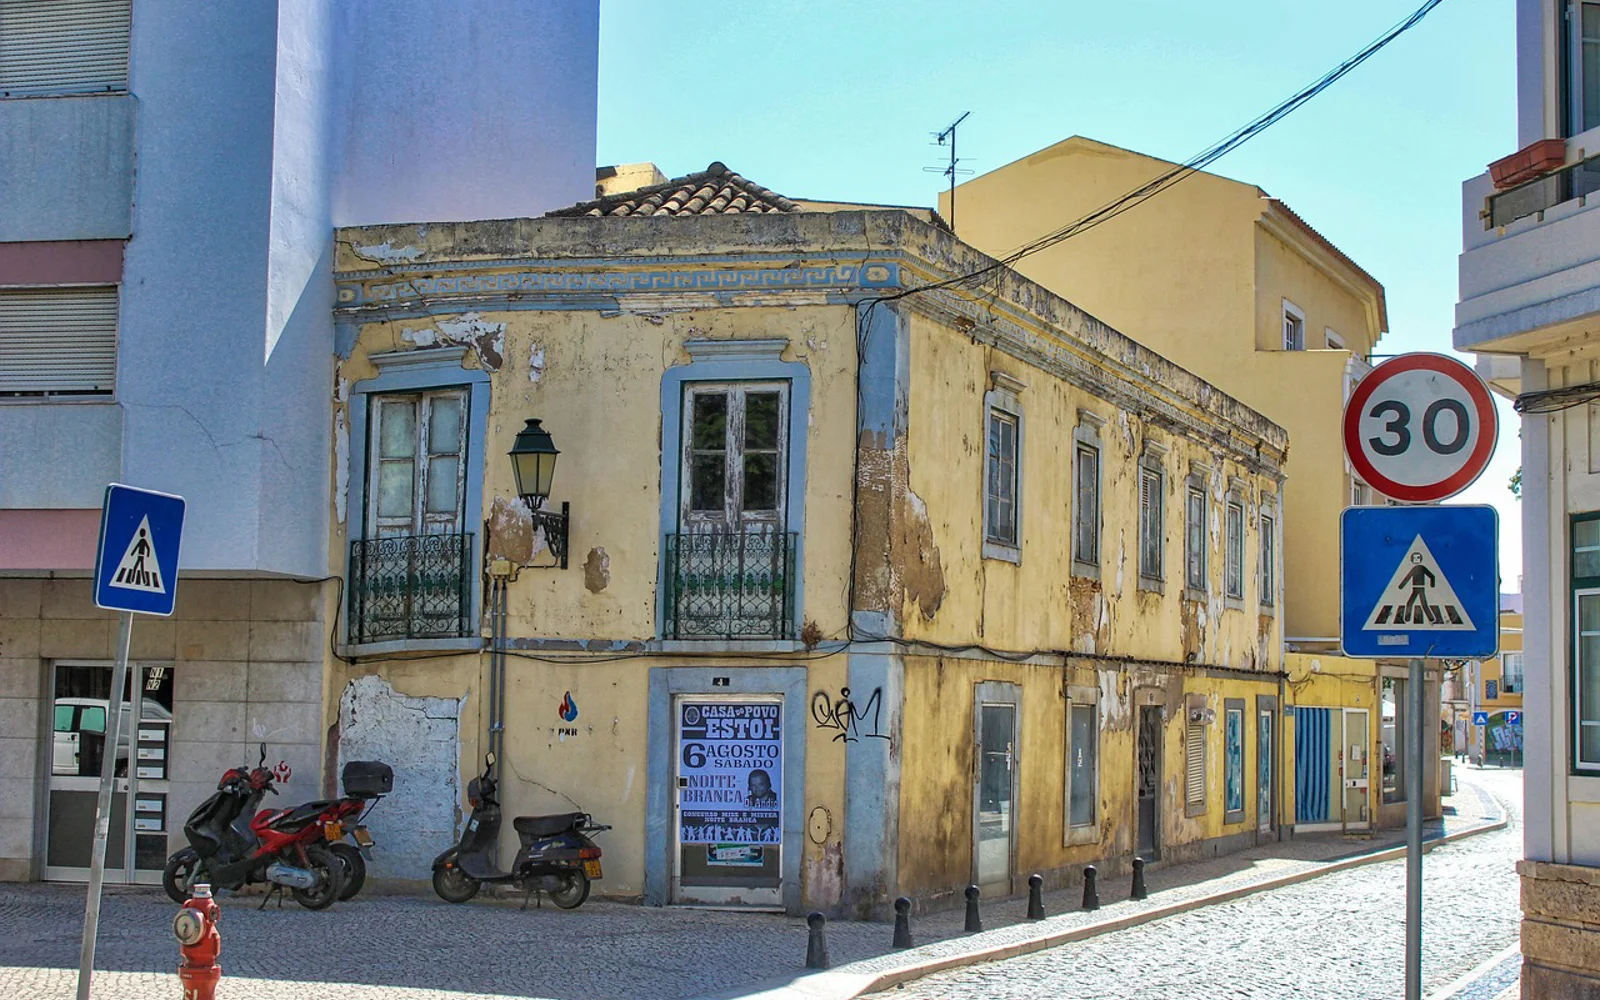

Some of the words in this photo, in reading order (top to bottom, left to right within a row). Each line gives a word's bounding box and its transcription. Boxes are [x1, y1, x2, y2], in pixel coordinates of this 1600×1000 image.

[1369, 398, 1470, 456] 30
[702, 706, 735, 718] CASA
[744, 706, 778, 718] POVO
[706, 718, 774, 739] ESTOI
[683, 743, 707, 768] 6
[706, 744, 779, 758] AGOSTO
[714, 759, 774, 768] SABADO
[689, 775, 736, 788] NOITE
[683, 790, 743, 803] BRANCA
